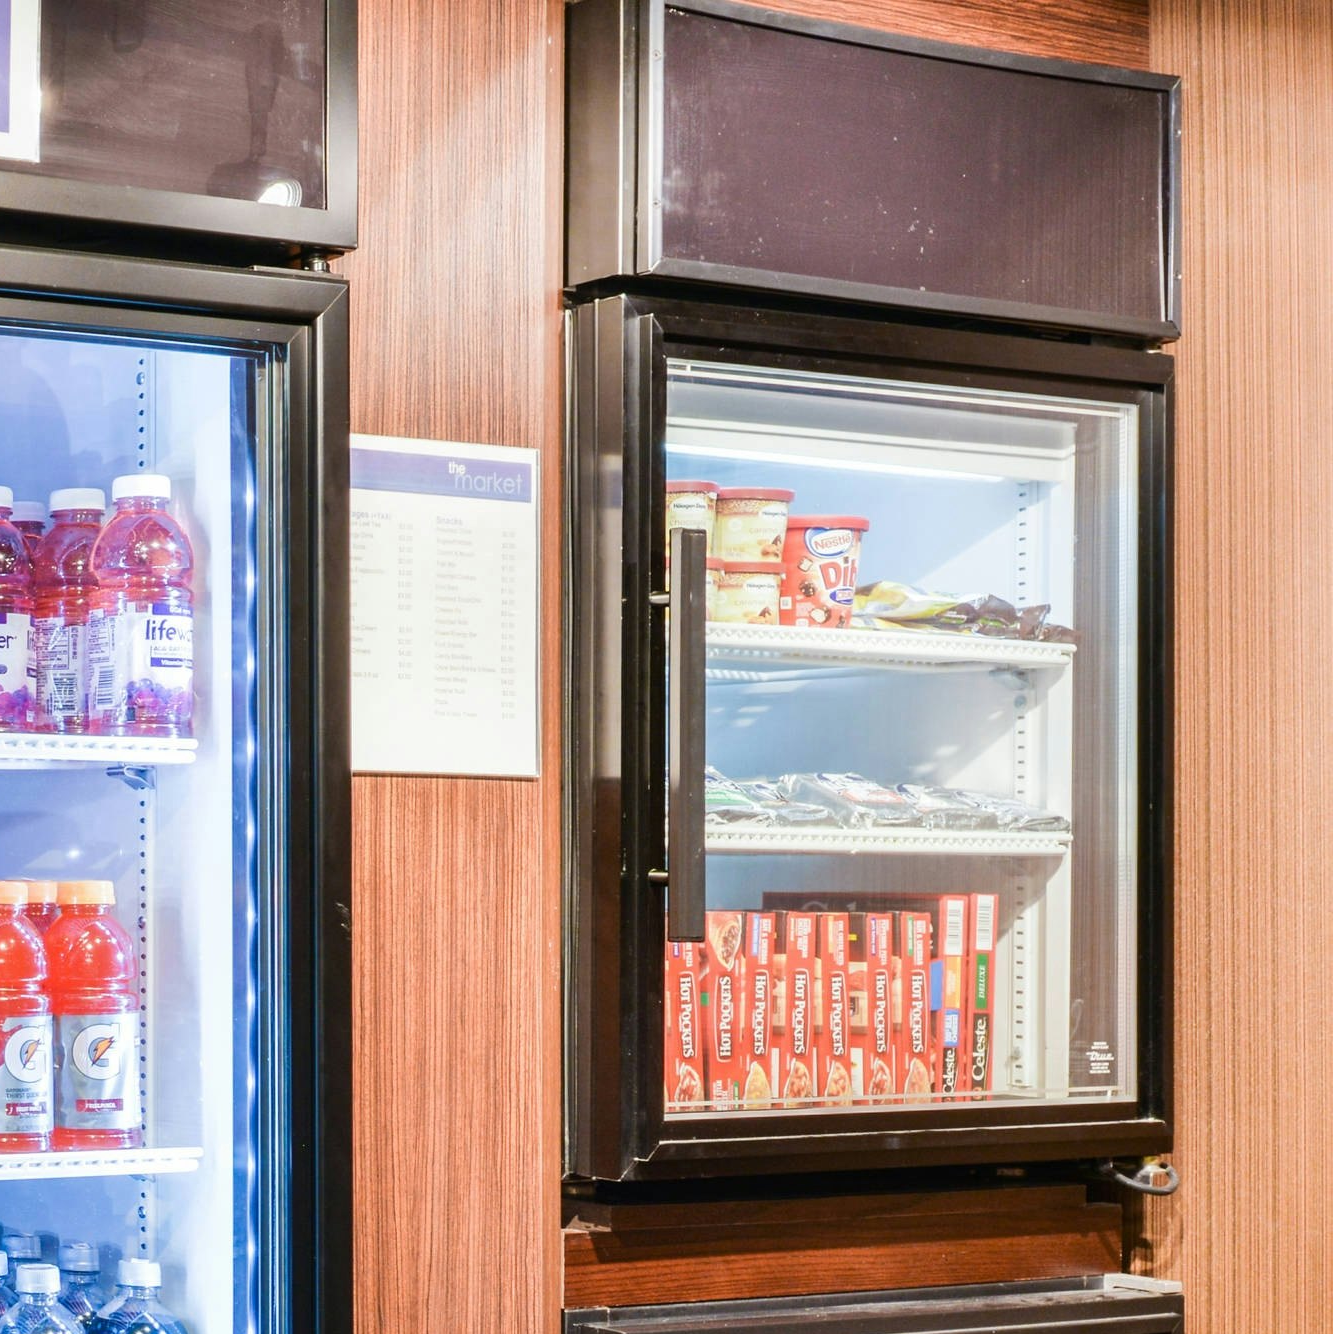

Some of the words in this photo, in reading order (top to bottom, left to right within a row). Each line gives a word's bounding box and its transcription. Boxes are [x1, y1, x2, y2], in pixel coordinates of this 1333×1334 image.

[448, 461, 465, 474] the
[454, 472, 522, 494] market
[814, 532, 851, 549] Nestlé
[680, 977, 691, 1003] HOT
[755, 976, 766, 1001] HOT
[795, 974, 806, 1000] HOT
[912, 976, 923, 1000] HOT
[719, 977, 732, 1030] POCKETS
[682, 1003, 694, 1058] POCKETS
[754, 1002, 765, 1055] POCKETS
[794, 1001, 806, 1054] POCKETS
[912, 1001, 923, 1053] POCKETS
[72, 1024, 121, 1079] G
[720, 1031, 731, 1057] HOT
